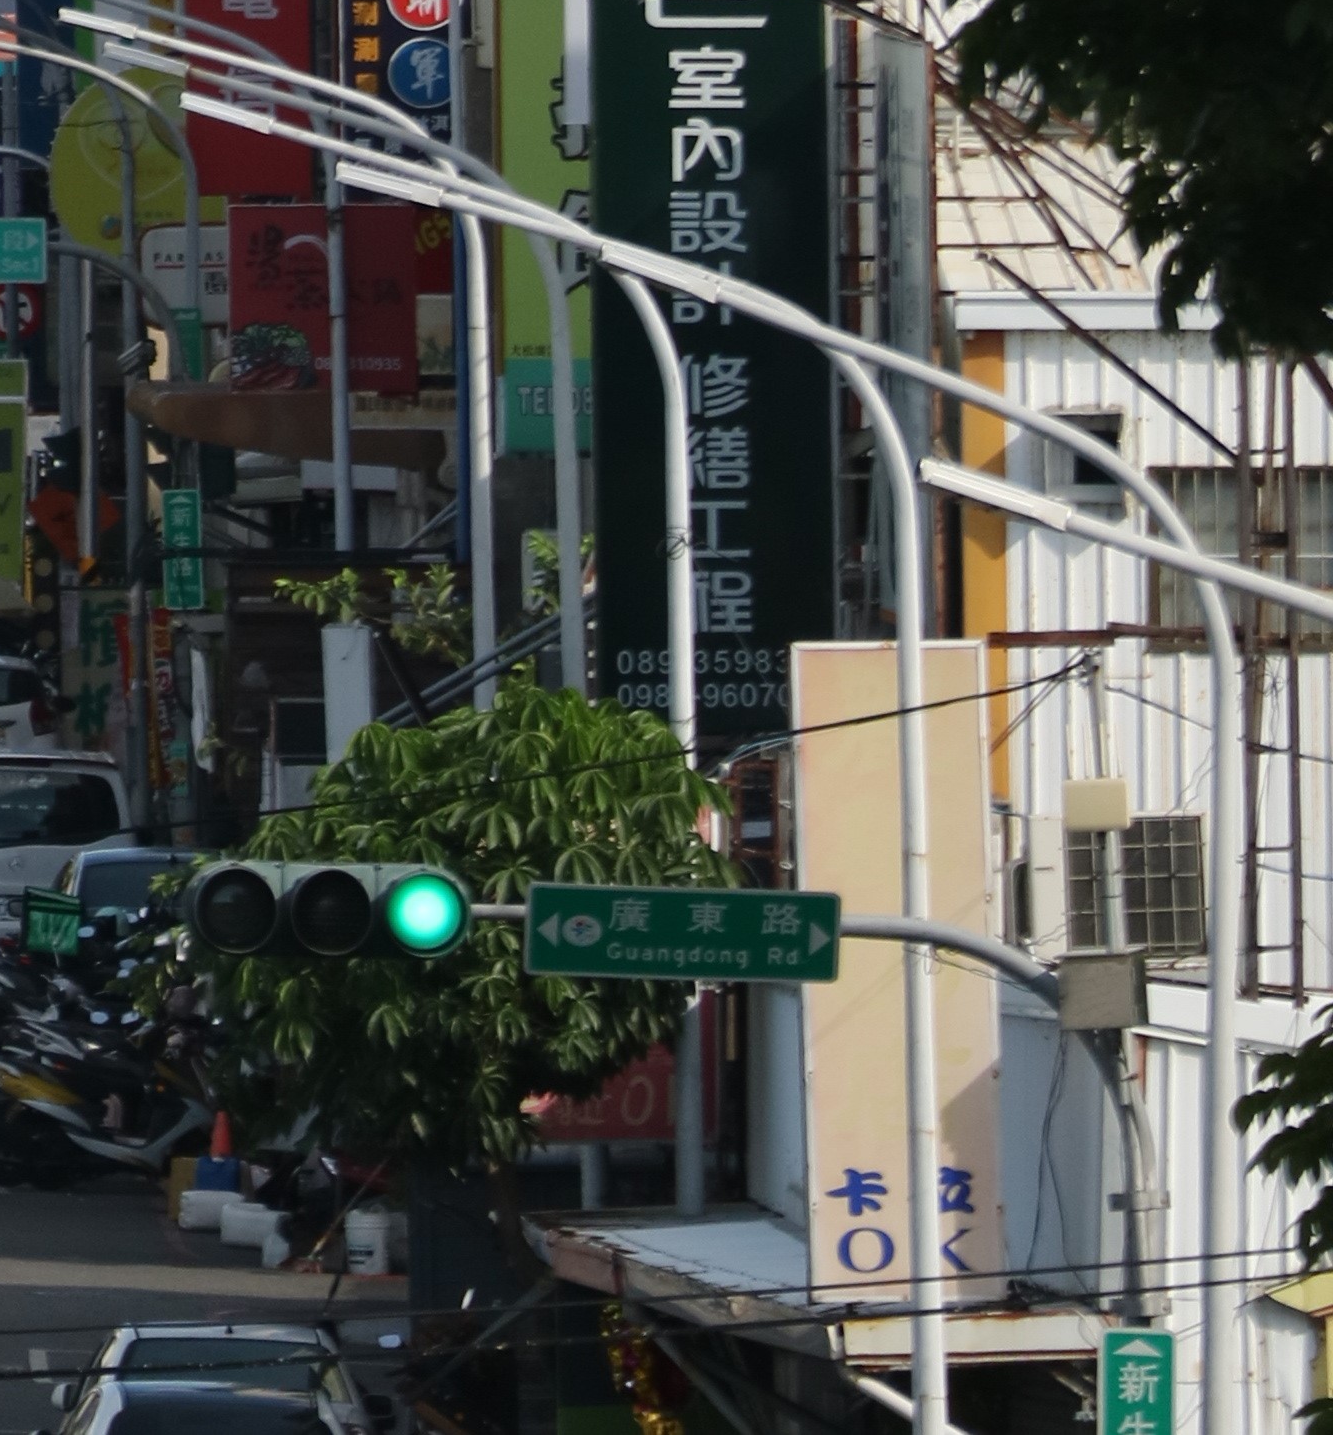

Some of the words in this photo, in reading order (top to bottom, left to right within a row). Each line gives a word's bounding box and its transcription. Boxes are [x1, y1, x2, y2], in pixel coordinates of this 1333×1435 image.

[608, 898, 803, 936] 廣東路
[606, 944, 750, 968] Guangdong
[768, 949, 800, 966] Rd
